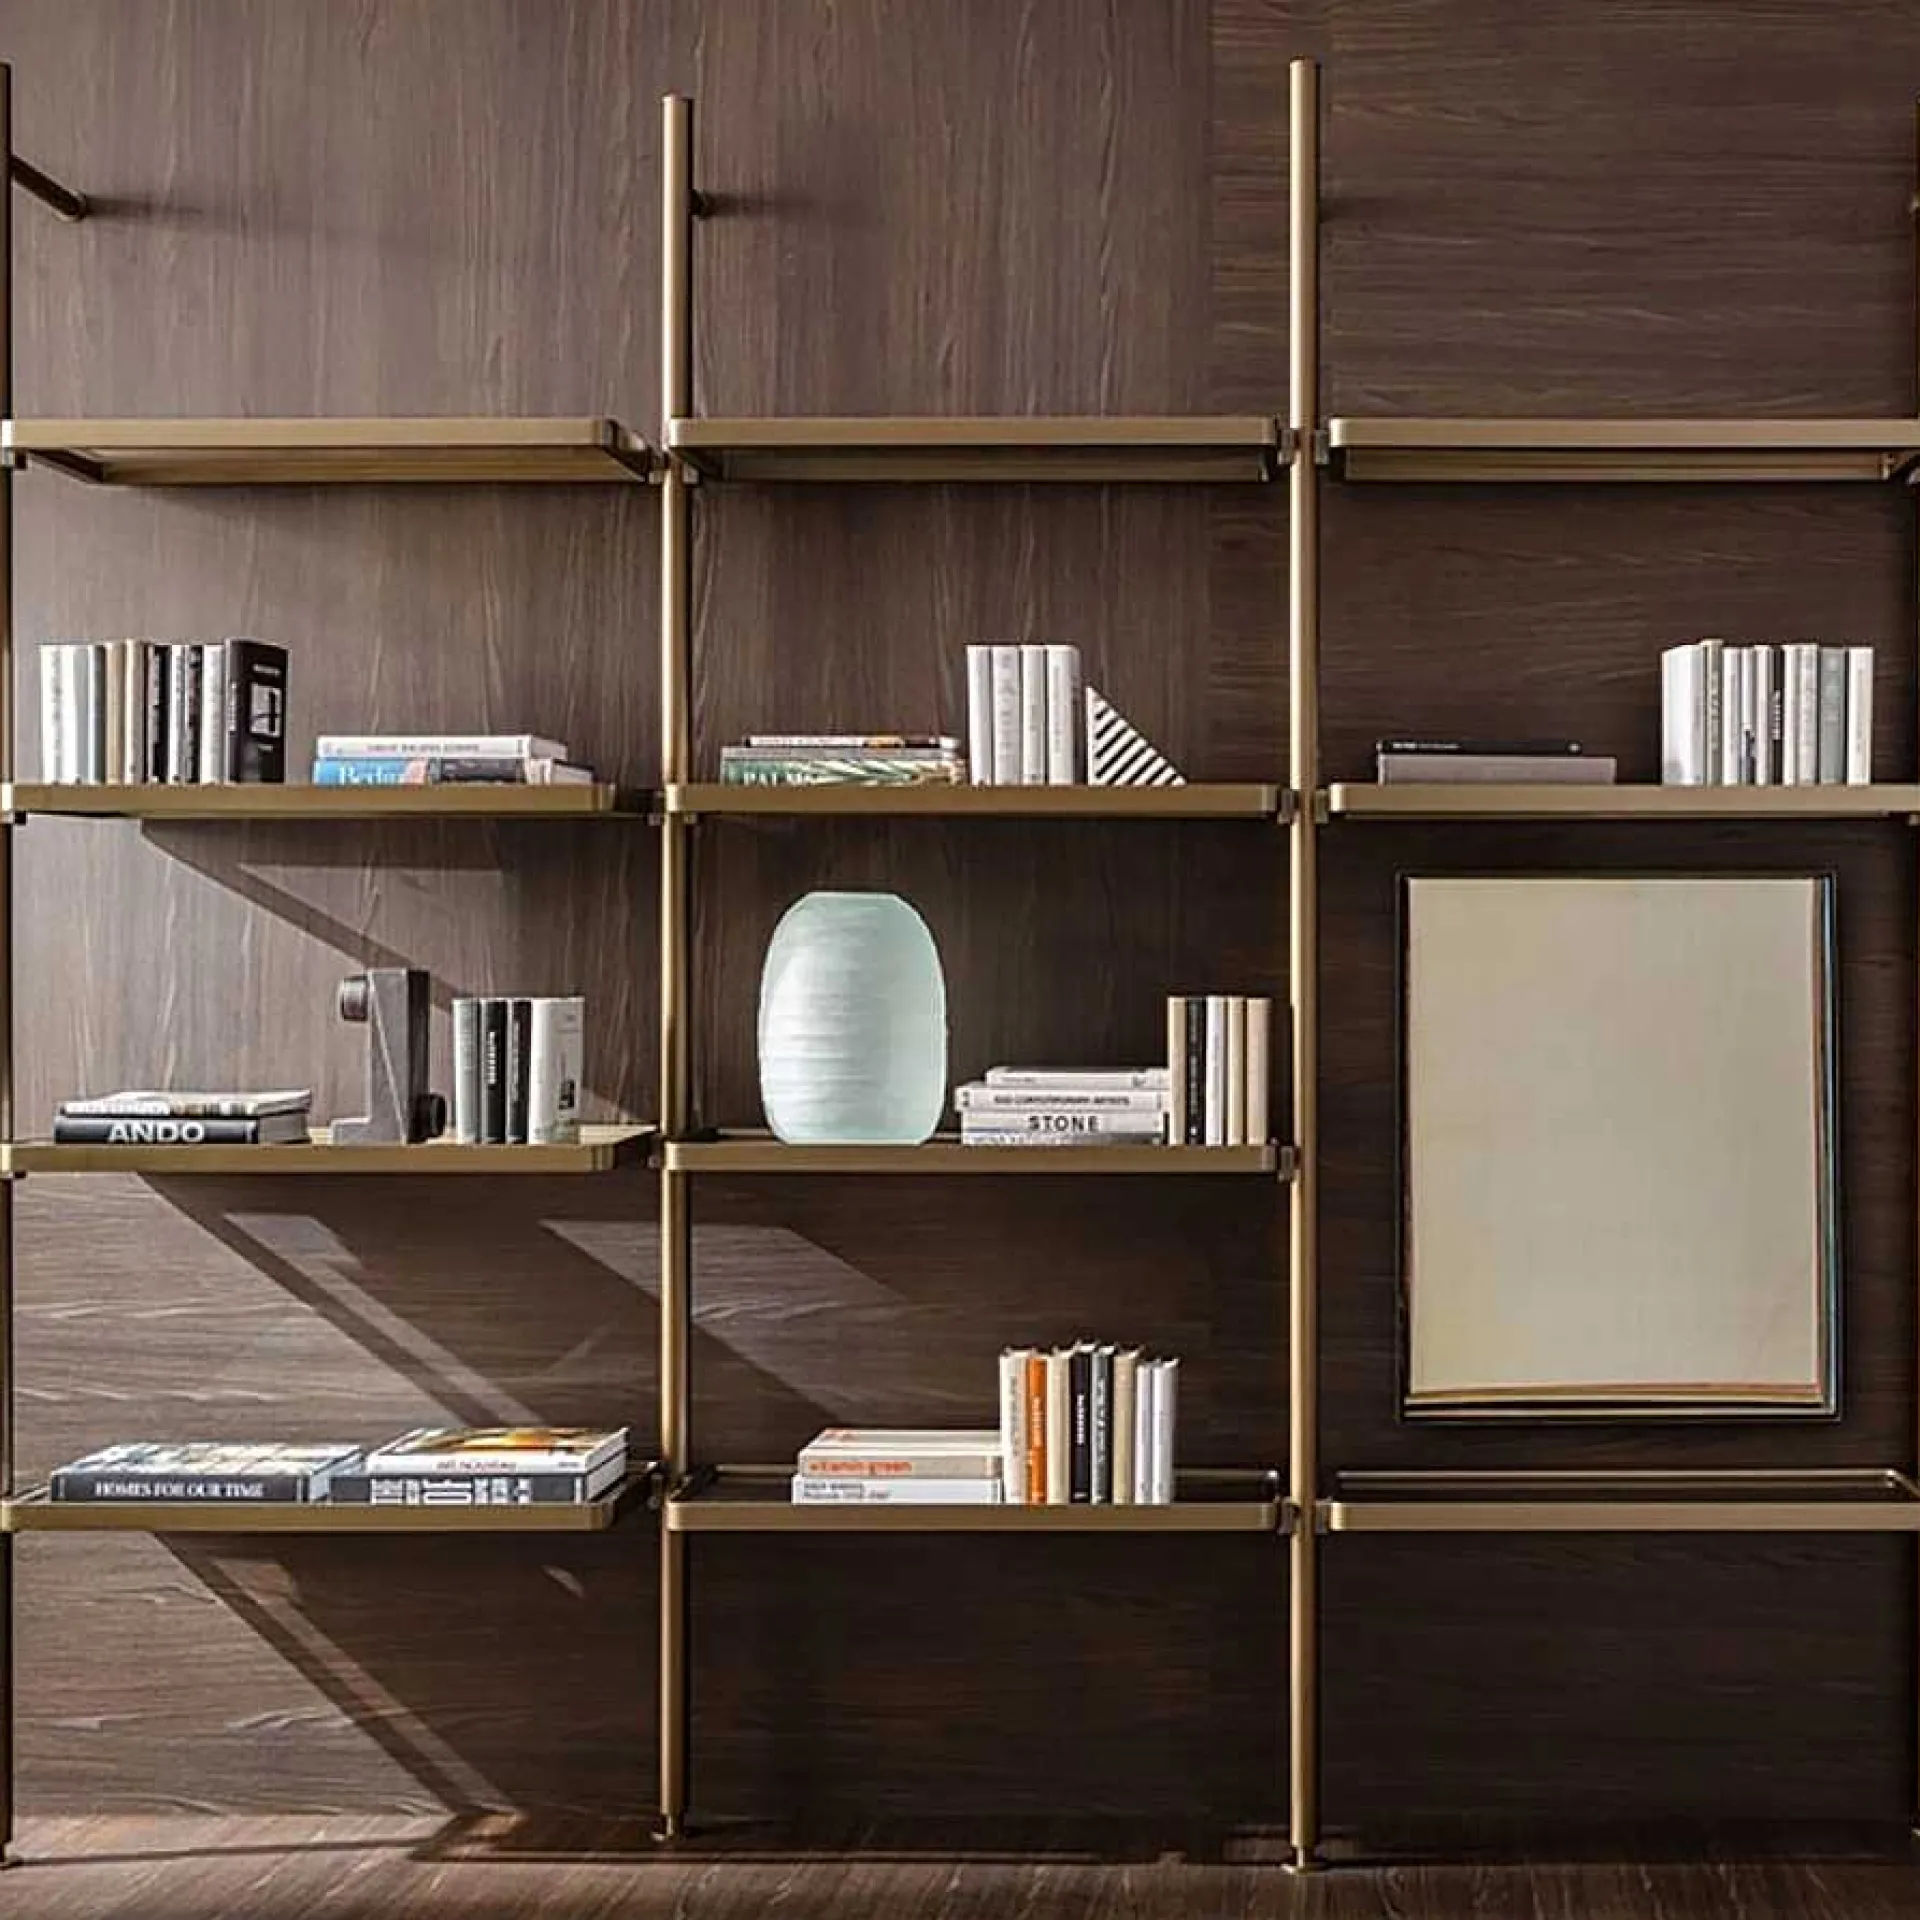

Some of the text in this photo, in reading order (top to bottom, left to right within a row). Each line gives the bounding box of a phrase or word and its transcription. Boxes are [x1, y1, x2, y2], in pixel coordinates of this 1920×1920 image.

[107, 1120, 205, 1143] ANDO
[1027, 1114, 1100, 1132] STONE
[94, 1481, 264, 1497] HOMES FOR OUR TIME
